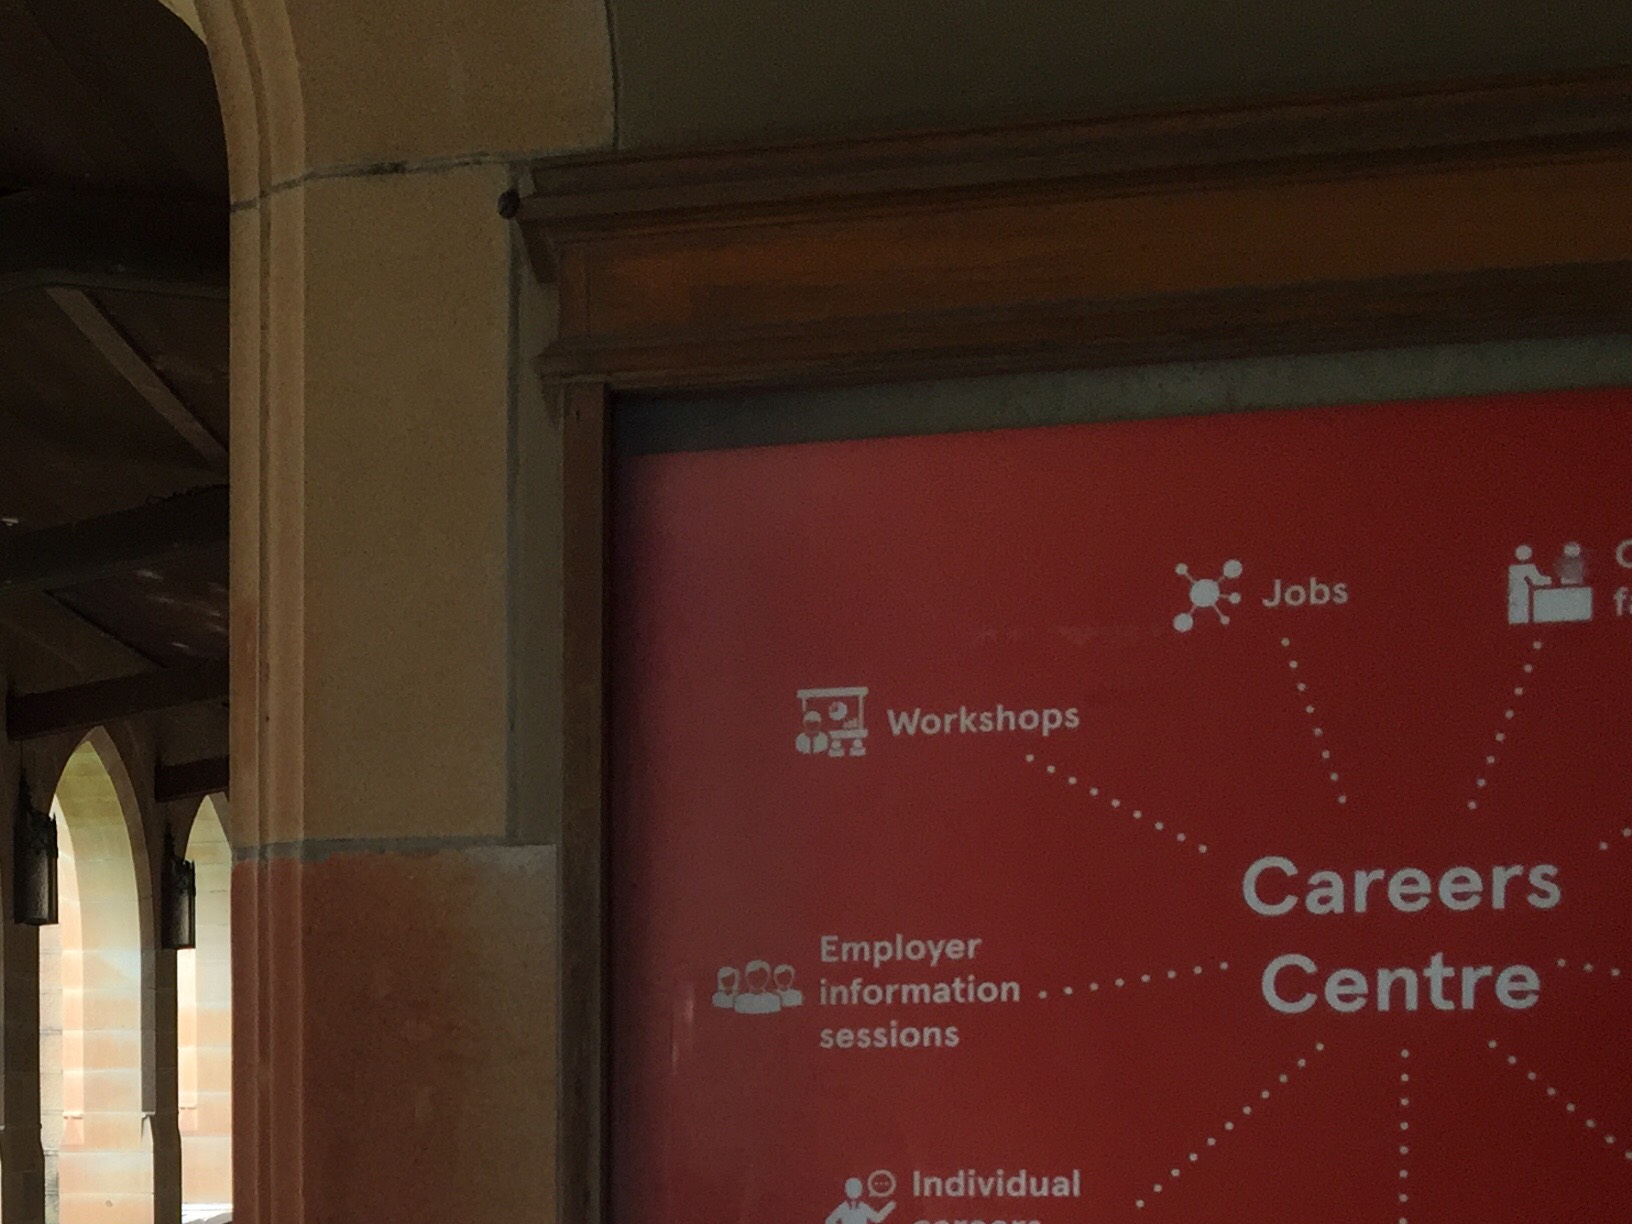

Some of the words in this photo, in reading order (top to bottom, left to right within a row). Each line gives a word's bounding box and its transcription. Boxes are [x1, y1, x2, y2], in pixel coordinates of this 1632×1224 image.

[1263, 577, 1349, 608] Jobs
[887, 704, 1080, 738] Workshops
[1242, 856, 1562, 917] Careers
[821, 933, 981, 968] Employer
[821, 974, 1020, 1005] information
[1261, 952, 1541, 1015] Centre
[821, 1020, 960, 1049] sessions
[913, 1168, 1080, 1197] Individual
